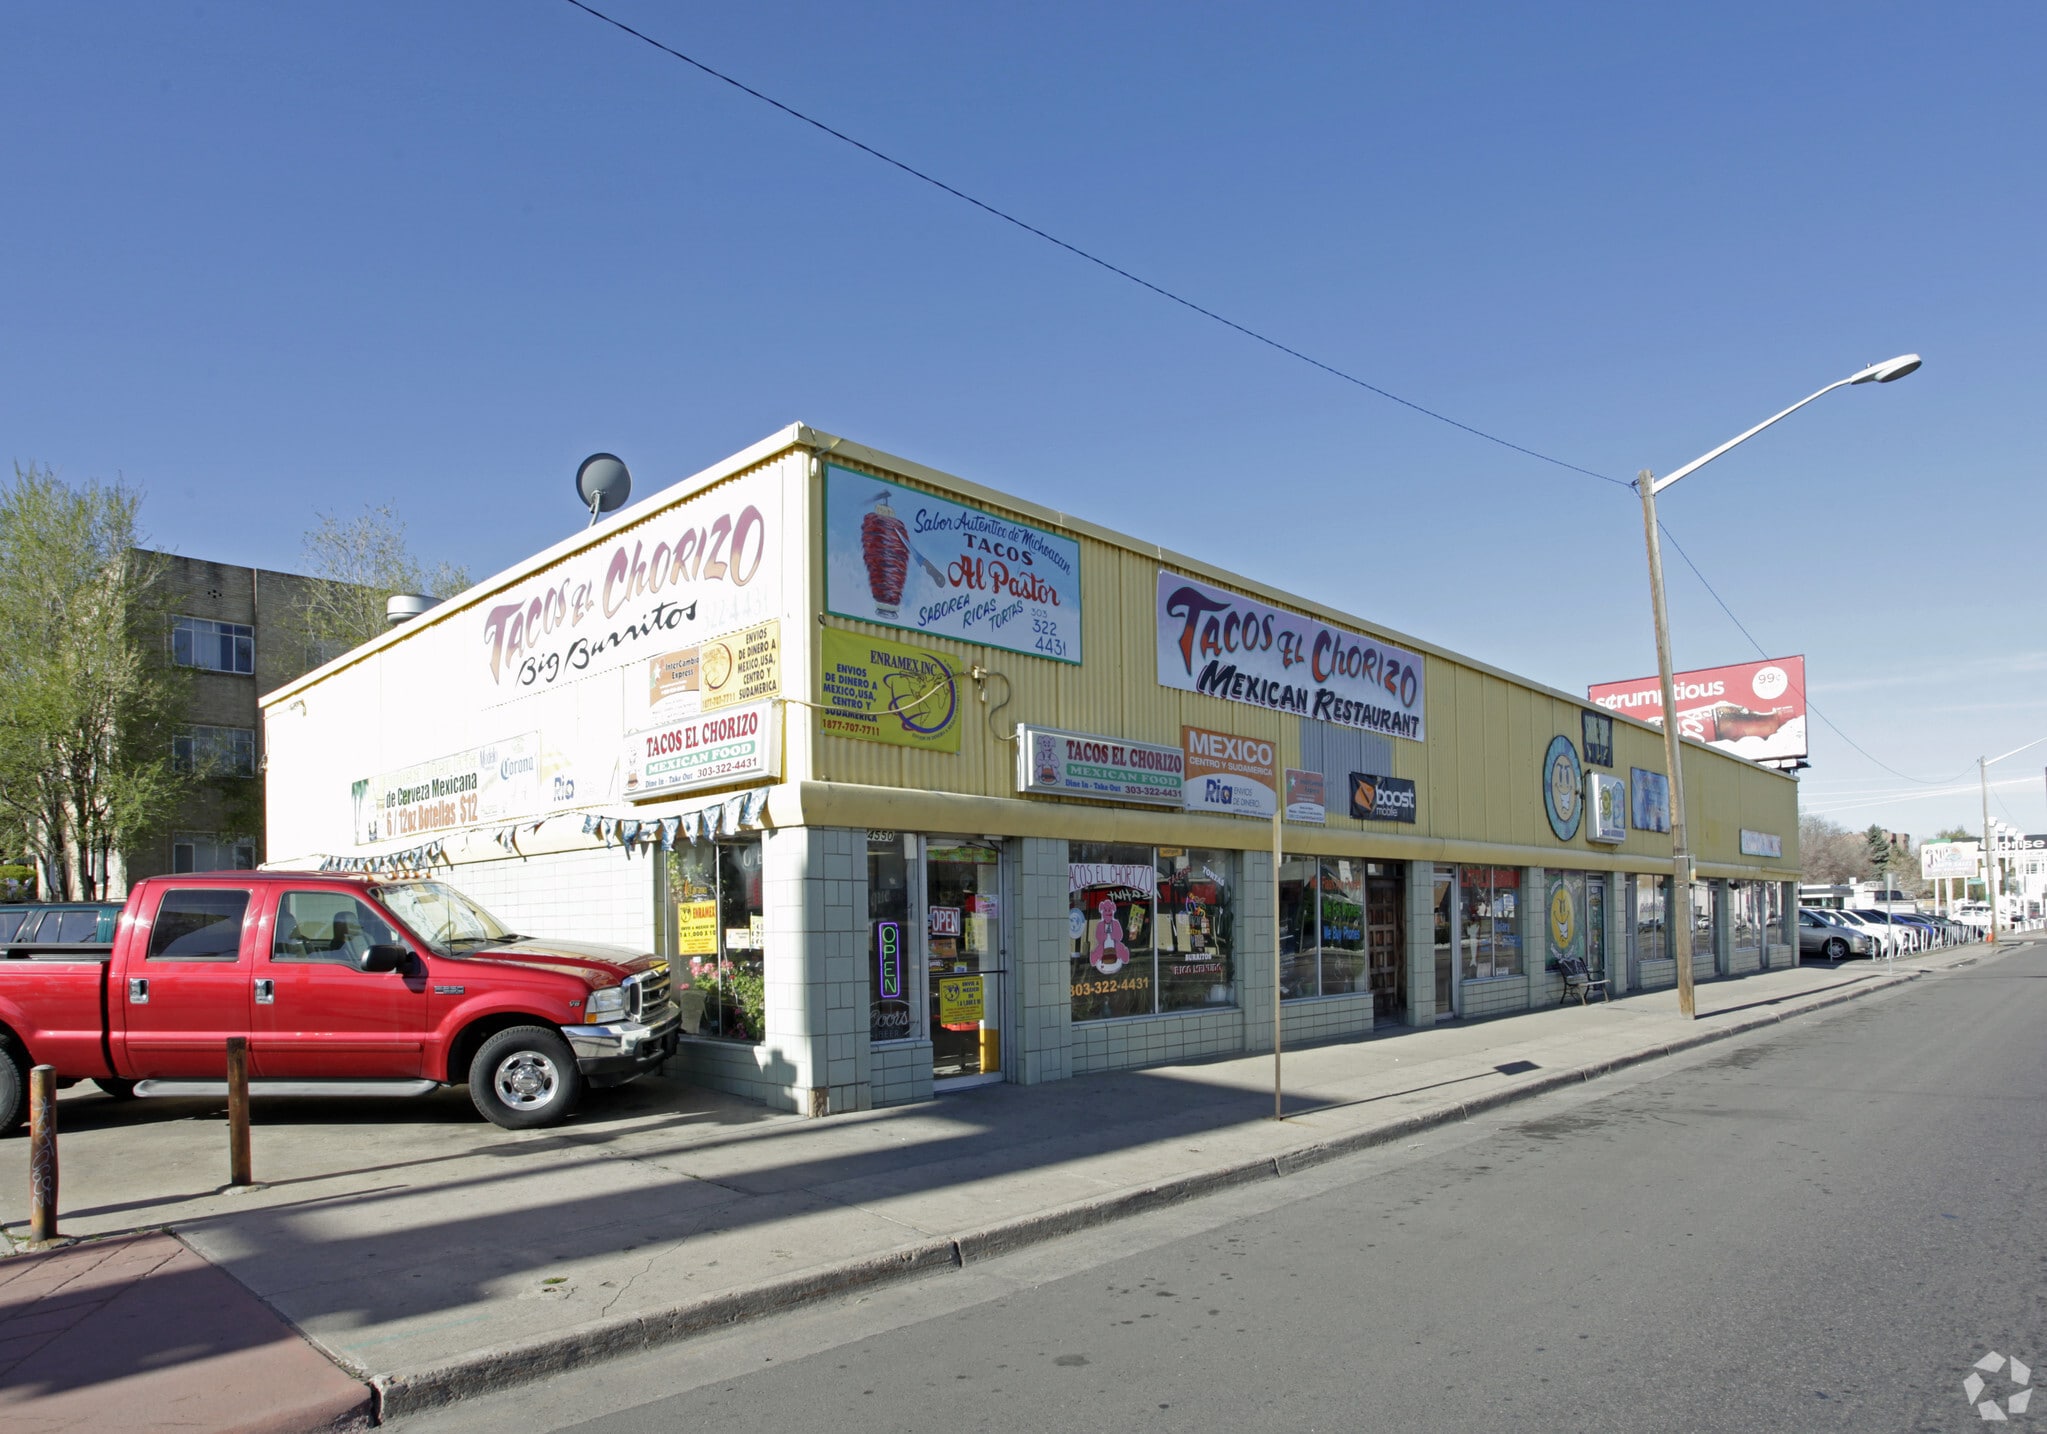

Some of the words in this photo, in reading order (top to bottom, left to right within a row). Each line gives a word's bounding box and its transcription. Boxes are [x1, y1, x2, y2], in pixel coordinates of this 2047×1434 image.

[914, 509, 952, 533] Sabor
[1008, 528, 1020, 543] de
[1019, 528, 1071, 577] Michoacan
[963, 533, 1034, 566] TACOS
[948, 554, 986, 590] Al
[989, 560, 1061, 606] Pastor
[917, 593, 970, 627] SABOREA
[962, 600, 997, 629] RICAS
[989, 600, 1023, 632] TORTAS
[746, 628, 768, 645] ENVIOS
[1032, 618, 1057, 636] 322
[515, 652, 560, 688] Big
[563, 599, 698, 675] Burritos
[738, 649, 747, 660] DE
[747, 642, 769, 658] DINERO
[771, 639, 777, 650] A
[1035, 636, 1066, 656] 4431
[671, 669, 694, 680] Express
[836, 663, 867, 677] ENVIOS
[870, 650, 919, 673] ENRAMEX
[920, 661, 937, 676] INC
[743, 670, 765, 685] CENTRO
[766, 667, 771, 678] Y
[825, 672, 836, 681] DE
[838, 675, 869, 689] DINERO
[872, 681, 878, 690] A
[739, 680, 777, 700] SUDAMERICA
[1197, 659, 1308, 714] MEXICAN
[1312, 687, 1420, 738] RESTAURANT
[832, 696, 863, 709] CENTRO
[866, 702, 871, 711] Y
[646, 729, 682, 758] TACOS
[685, 726, 699, 749] EL
[702, 711, 758, 745] CHORIZO
[822, 719, 880, 737] 1877-707-7711
[648, 752, 709, 774] MEXICAN
[712, 742, 753, 761] FOOD
[1065, 740, 1108, 765] TACOS
[1112, 747, 1127, 767] EL
[1129, 749, 1182, 773] CHORIZO
[1189, 731, 1273, 766] MEXICO
[500, 753, 534, 781] Corona
[697, 757, 757, 778] 303-322-4431
[1070, 765, 1137, 782] MEXICAN
[1142, 774, 1178, 787] FOOD
[1189, 756, 1220, 769] CENTRO
[1221, 760, 1227, 769] Y
[1228, 761, 1273, 777] SUDAMERICA
[386, 793, 396, 809] de
[397, 784, 430, 806] Cerveza
[432, 772, 478, 796] Mexicana
[1065, 779, 1079, 789] Dine
[1081, 781, 1088, 789] In
[1094, 782, 1107, 792] Take
[1109, 783, 1121, 793] Out
[1125, 785, 1182, 798] 303-322-4431
[1205, 779, 1232, 805] Ria
[1376, 785, 1415, 809] boost
[386, 811, 392, 836] 6
[399, 807, 417, 834] 12oz
[418, 801, 456, 830] Botellas
[460, 792, 478, 825] $12
[1376, 807, 1398, 817] mobile
[867, 830, 894, 841] 4550
[1096, 865, 1106, 884] EL
[1110, 865, 1153, 893] CHORIZO
[933, 910, 958, 932] OPEN
[882, 926, 897, 994] OPEN
